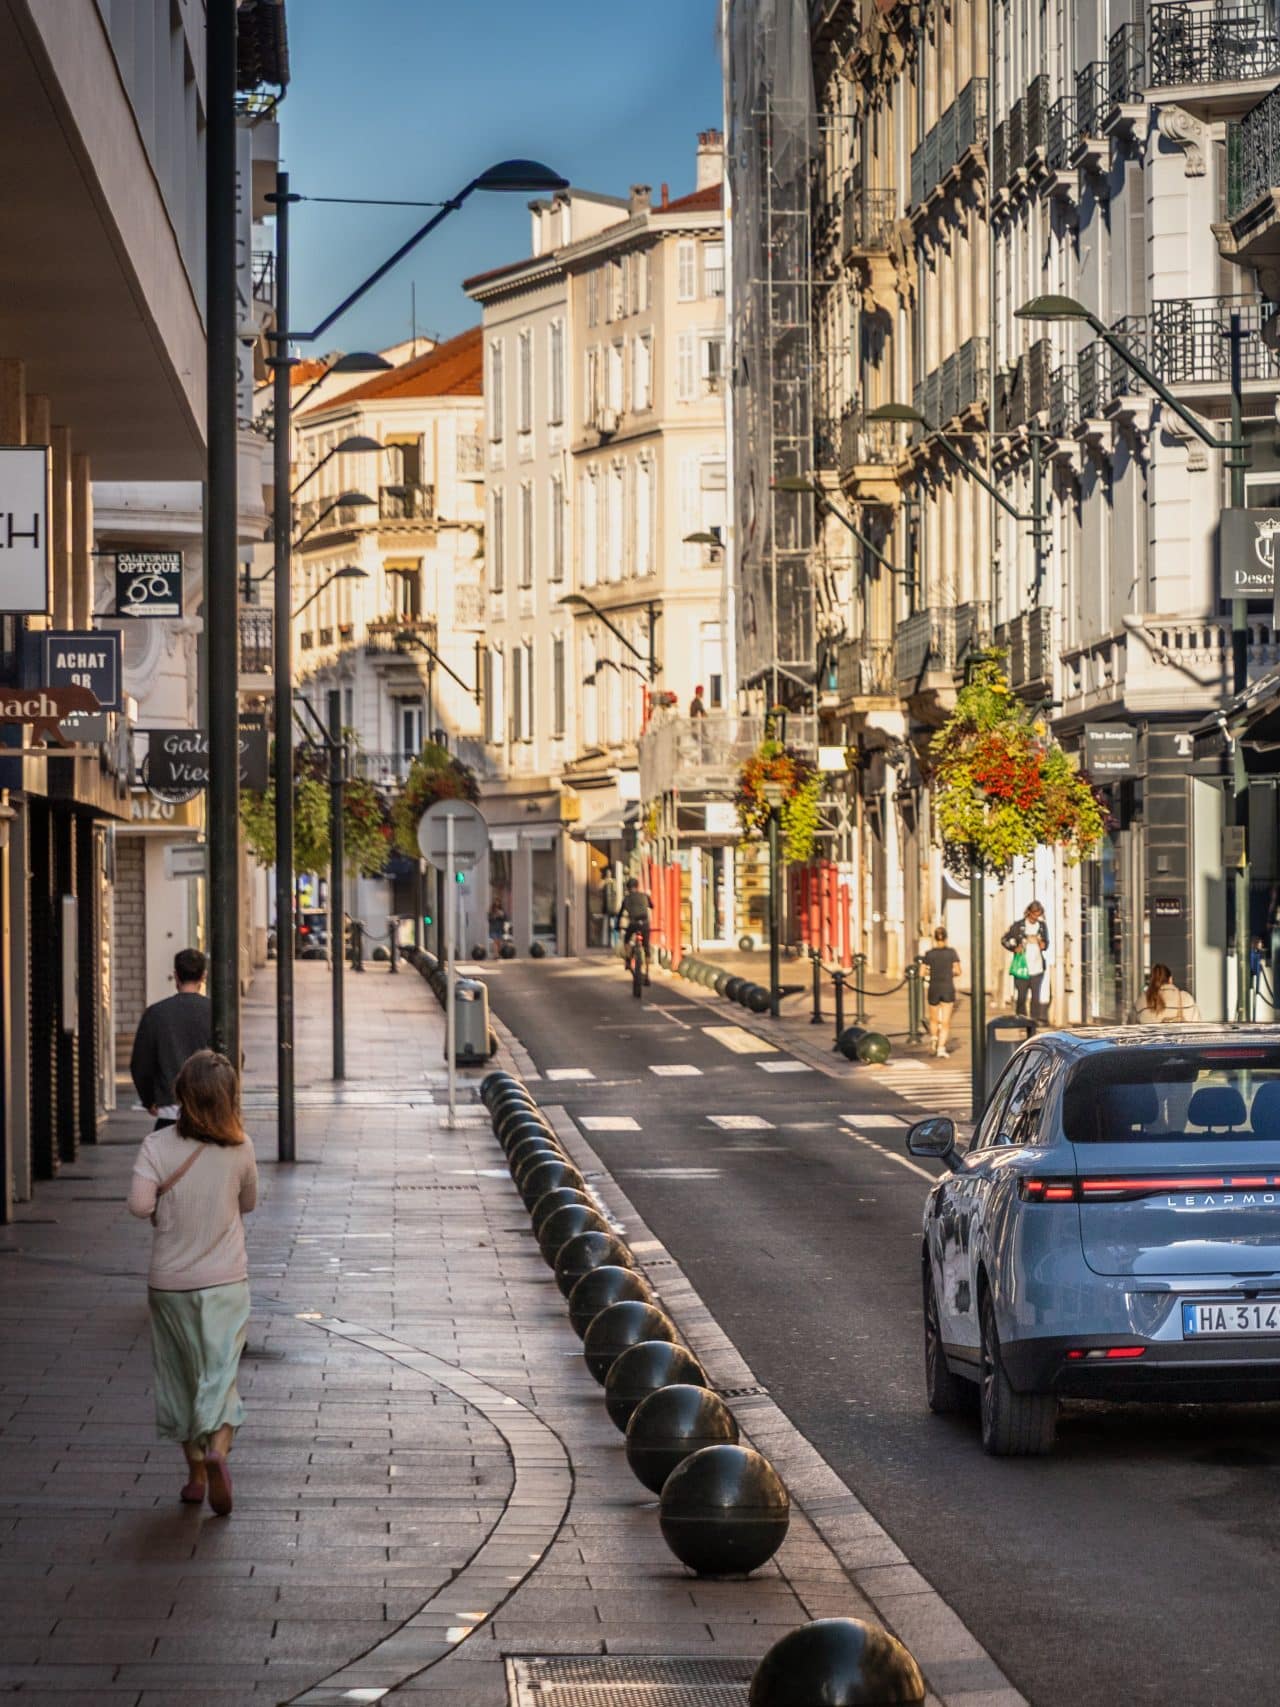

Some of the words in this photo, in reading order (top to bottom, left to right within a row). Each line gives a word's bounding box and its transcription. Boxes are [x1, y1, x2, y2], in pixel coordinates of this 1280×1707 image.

[0, 513, 39, 549] H
[118, 562, 181, 575] OPTIQUE
[56, 653, 107, 669] ACHAT
[70, 673, 92, 689] OR
